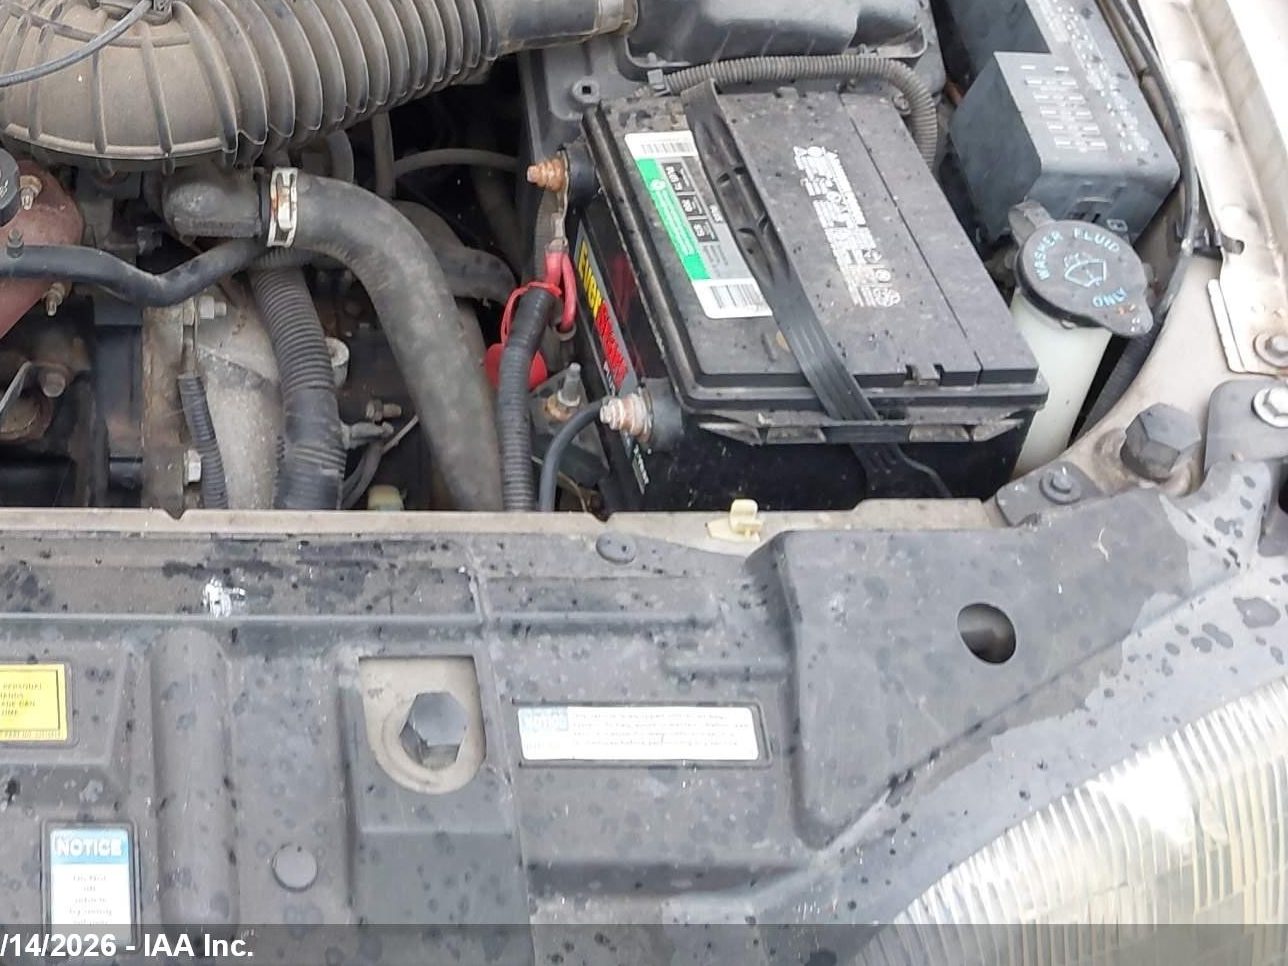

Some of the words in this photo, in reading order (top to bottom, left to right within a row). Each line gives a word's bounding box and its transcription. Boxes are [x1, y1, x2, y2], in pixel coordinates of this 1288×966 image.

[1034, 231, 1064, 281] WASHER
[1073, 227, 1121, 253] FLUID
[1093, 287, 1129, 308] ONLY
[57, 836, 122, 857] NOTICE
